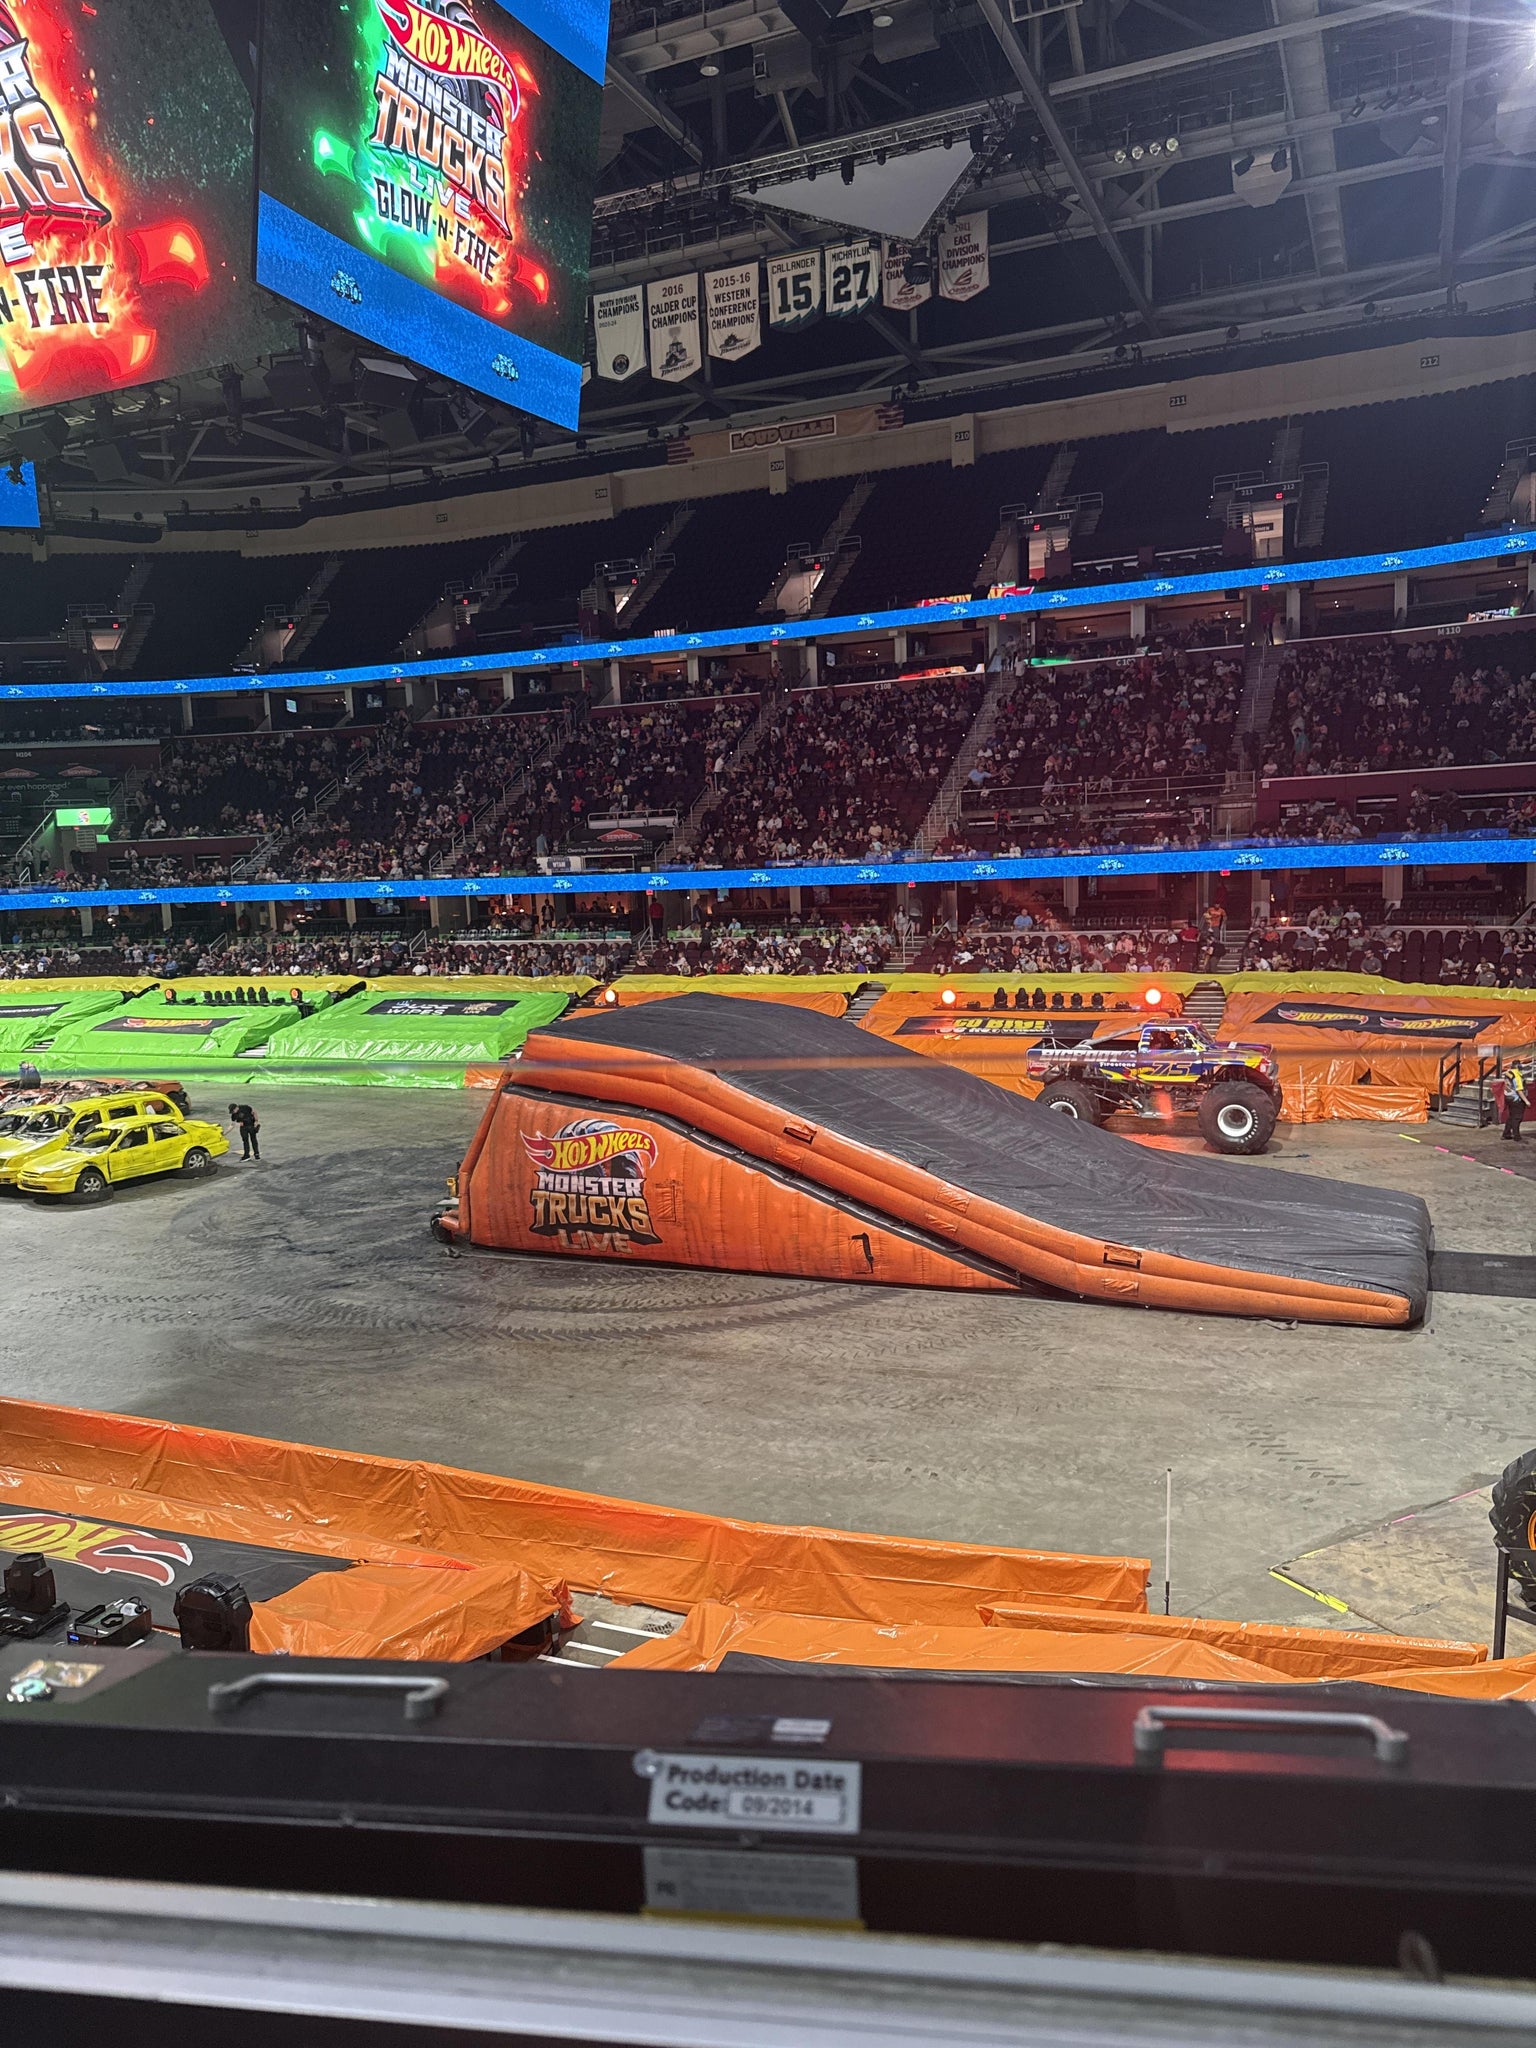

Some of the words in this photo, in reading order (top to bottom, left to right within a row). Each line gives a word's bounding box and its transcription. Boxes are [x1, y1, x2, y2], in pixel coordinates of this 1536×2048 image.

[404, 2, 451, 67] HOT
[385, 44, 507, 159] MONSTER
[370, 74, 512, 239] TRUCKS
[408, 161, 472, 221] LIVE
[954, 233, 972, 246] EAST
[832, 246, 871, 262] MICHAYLUK
[946, 243, 980, 258] DIVISION
[771, 257, 816, 275] CALLANDER
[942, 253, 986, 271] CHAMPIONS
[712, 271, 751, 289] 2015-16
[833, 261, 871, 303] 27
[662, 283, 684, 298] 2016
[714, 287, 751, 304] WESTERN
[777, 272, 812, 314] 15
[599, 298, 615, 308] NORTH
[615, 294, 637, 306] DIVISION
[651, 301, 679, 316] CALDER
[681, 295, 697, 310] CUP
[709, 299, 757, 318] CONFERENCE
[597, 302, 640, 320] CHAMPIONS
[651, 309, 697, 330] CHAMPIONS
[711, 313, 755, 330] CHAMPIONS
[1421, 356, 1439, 367] 212
[1169, 396, 1186, 406] 211
[732, 417, 835, 451] LOUDVILLE
[956, 431, 970, 442] 210
[771, 461, 784, 471] 209
[953, 1018, 983, 1028] GO
[1041, 1050, 1120, 1062] BIGFOOT
[1150, 1061, 1193, 1076] 75
[550, 1137, 589, 1169] HOT
[536, 1171, 646, 1197] MONSTER
[532, 1190, 657, 1240] TRUCKS
[557, 1228, 634, 1254] LIVE
[667, 1763, 787, 1788] Production
[794, 1770, 846, 1790] Date
[664, 1790, 727, 1813] Code:
